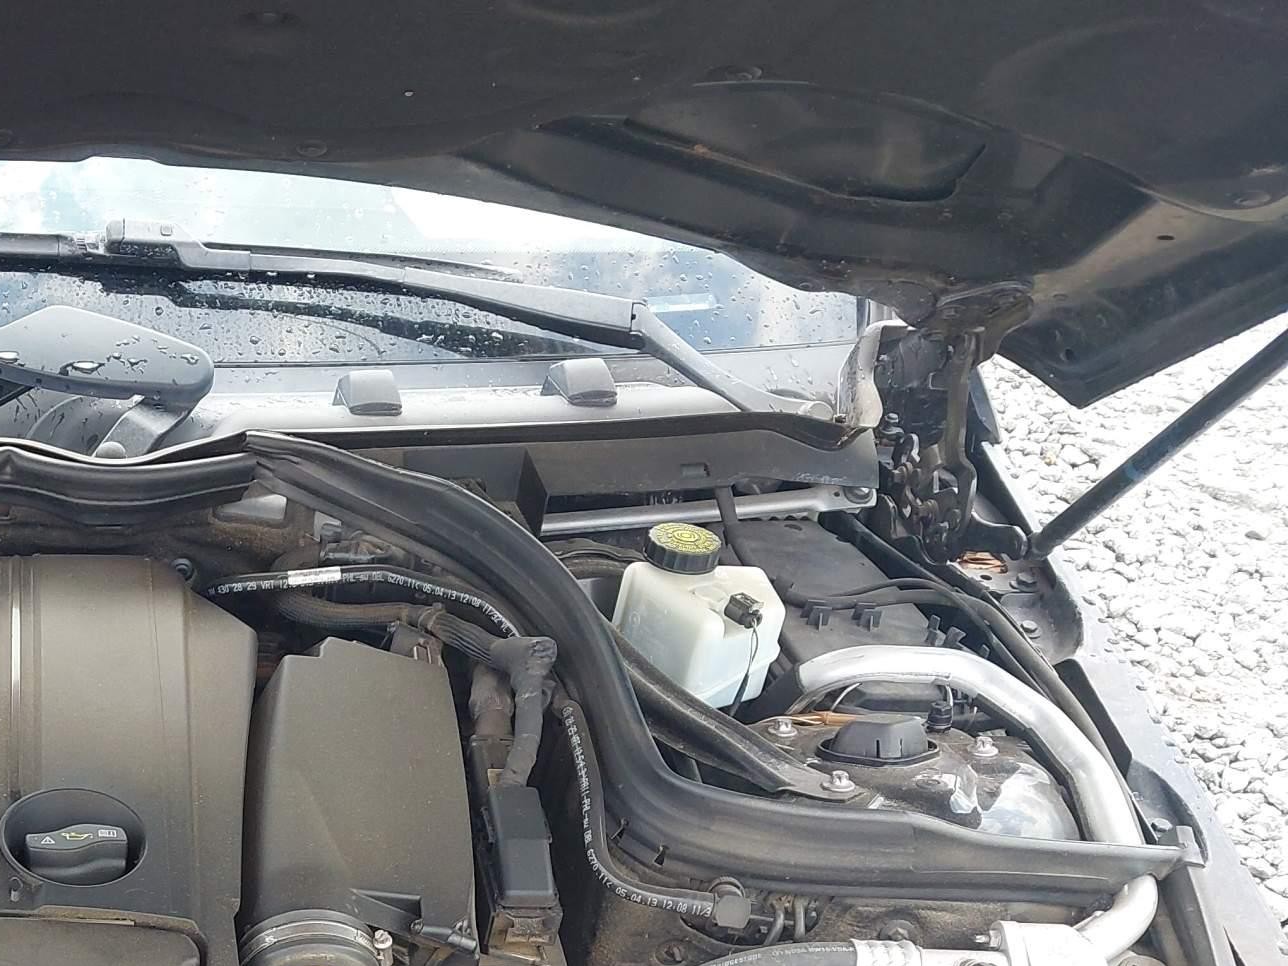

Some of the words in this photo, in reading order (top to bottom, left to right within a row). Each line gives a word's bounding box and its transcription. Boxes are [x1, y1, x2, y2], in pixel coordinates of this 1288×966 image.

[422, 583, 457, 600] 05.04.13
[459, 592, 482, 608] 12:08
[615, 886, 658, 907] 05.04.13
[662, 899, 689, 914] 12:08
